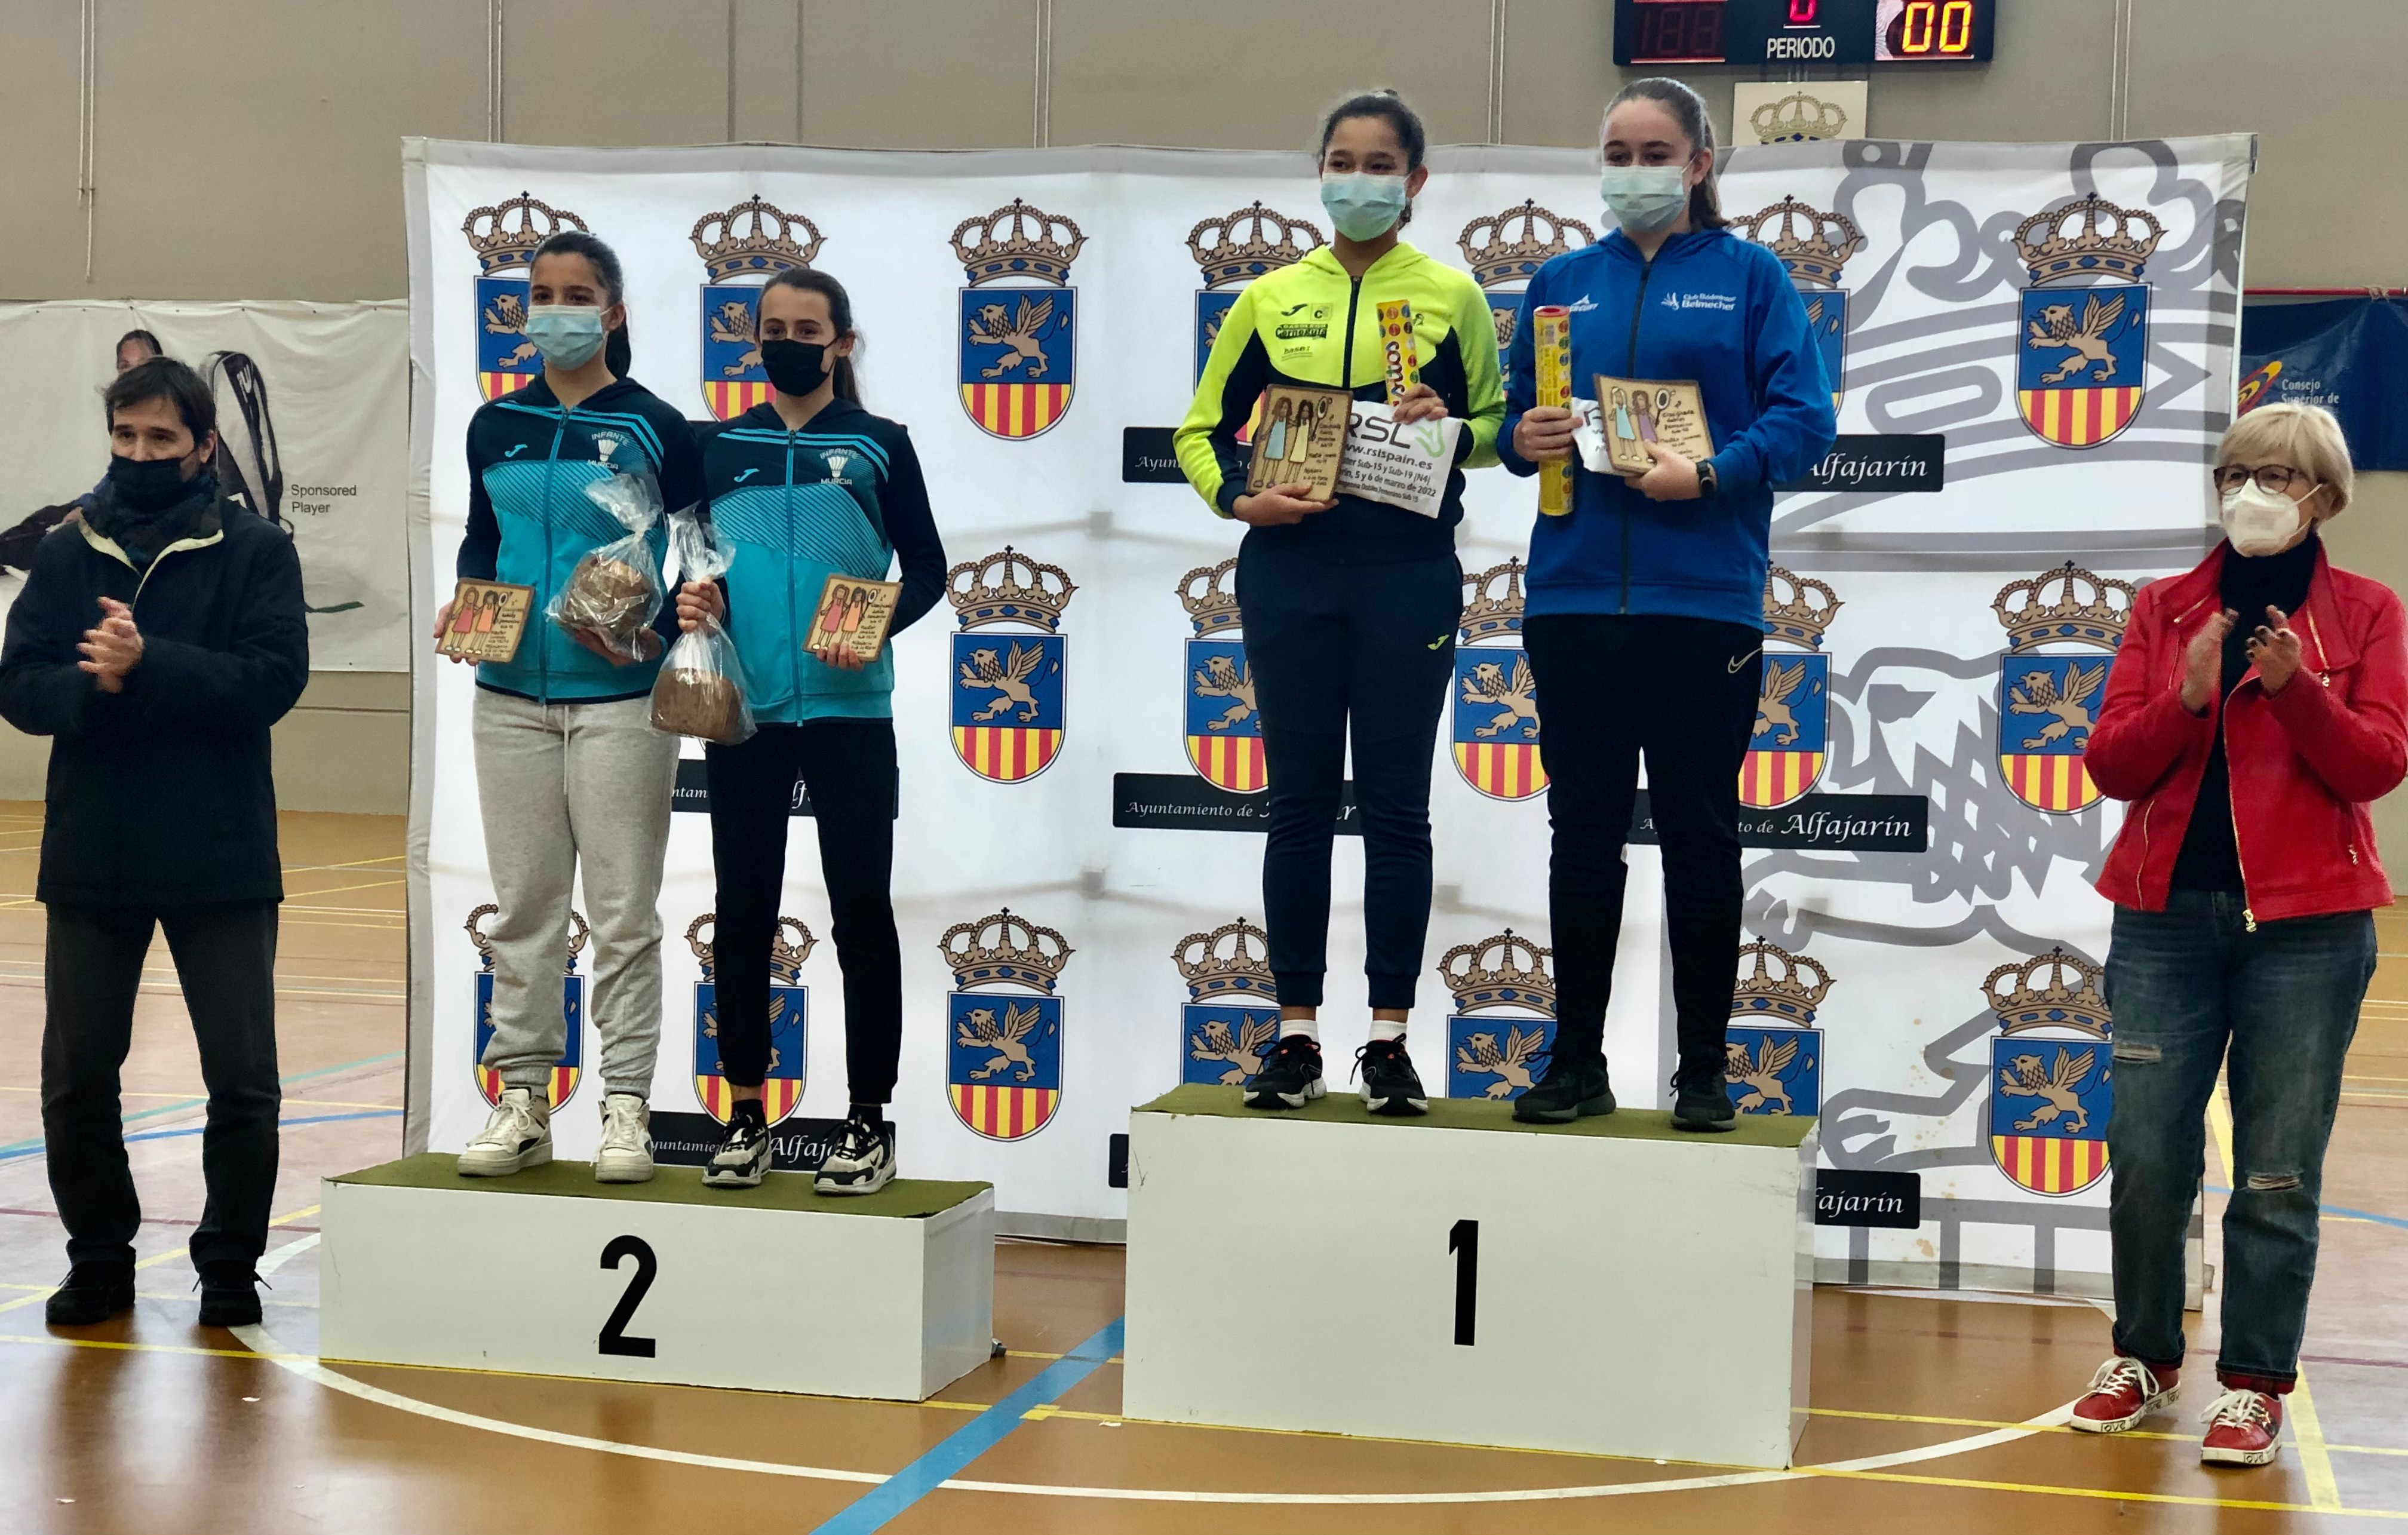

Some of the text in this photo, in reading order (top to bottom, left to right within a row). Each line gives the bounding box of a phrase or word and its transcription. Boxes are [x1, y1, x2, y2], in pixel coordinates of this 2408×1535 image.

[1767, 36, 1835, 59] PERIODO
[2282, 378, 2321, 393] Consejo
[2327, 392, 2340, 404] de
[1346, 444, 1433, 470] ww.rslspain.es
[291, 484, 357, 498] Sponsored
[1374, 474, 1384, 484] de
[1384, 478, 1406, 489] marzo
[1407, 483, 1417, 492] de
[1417, 486, 1437, 498] 2022
[292, 501, 331, 516] Player
[1126, 801, 1233, 818] Ayuntamiento
[1237, 803, 1254, 817] de
[1756, 818, 1774, 834] de
[1781, 811, 1912, 843] Alfajarín
[1816, 1187, 1905, 1218] ajarín
[1449, 1219, 1479, 1346] 1
[598, 1235, 657, 1358] 2
